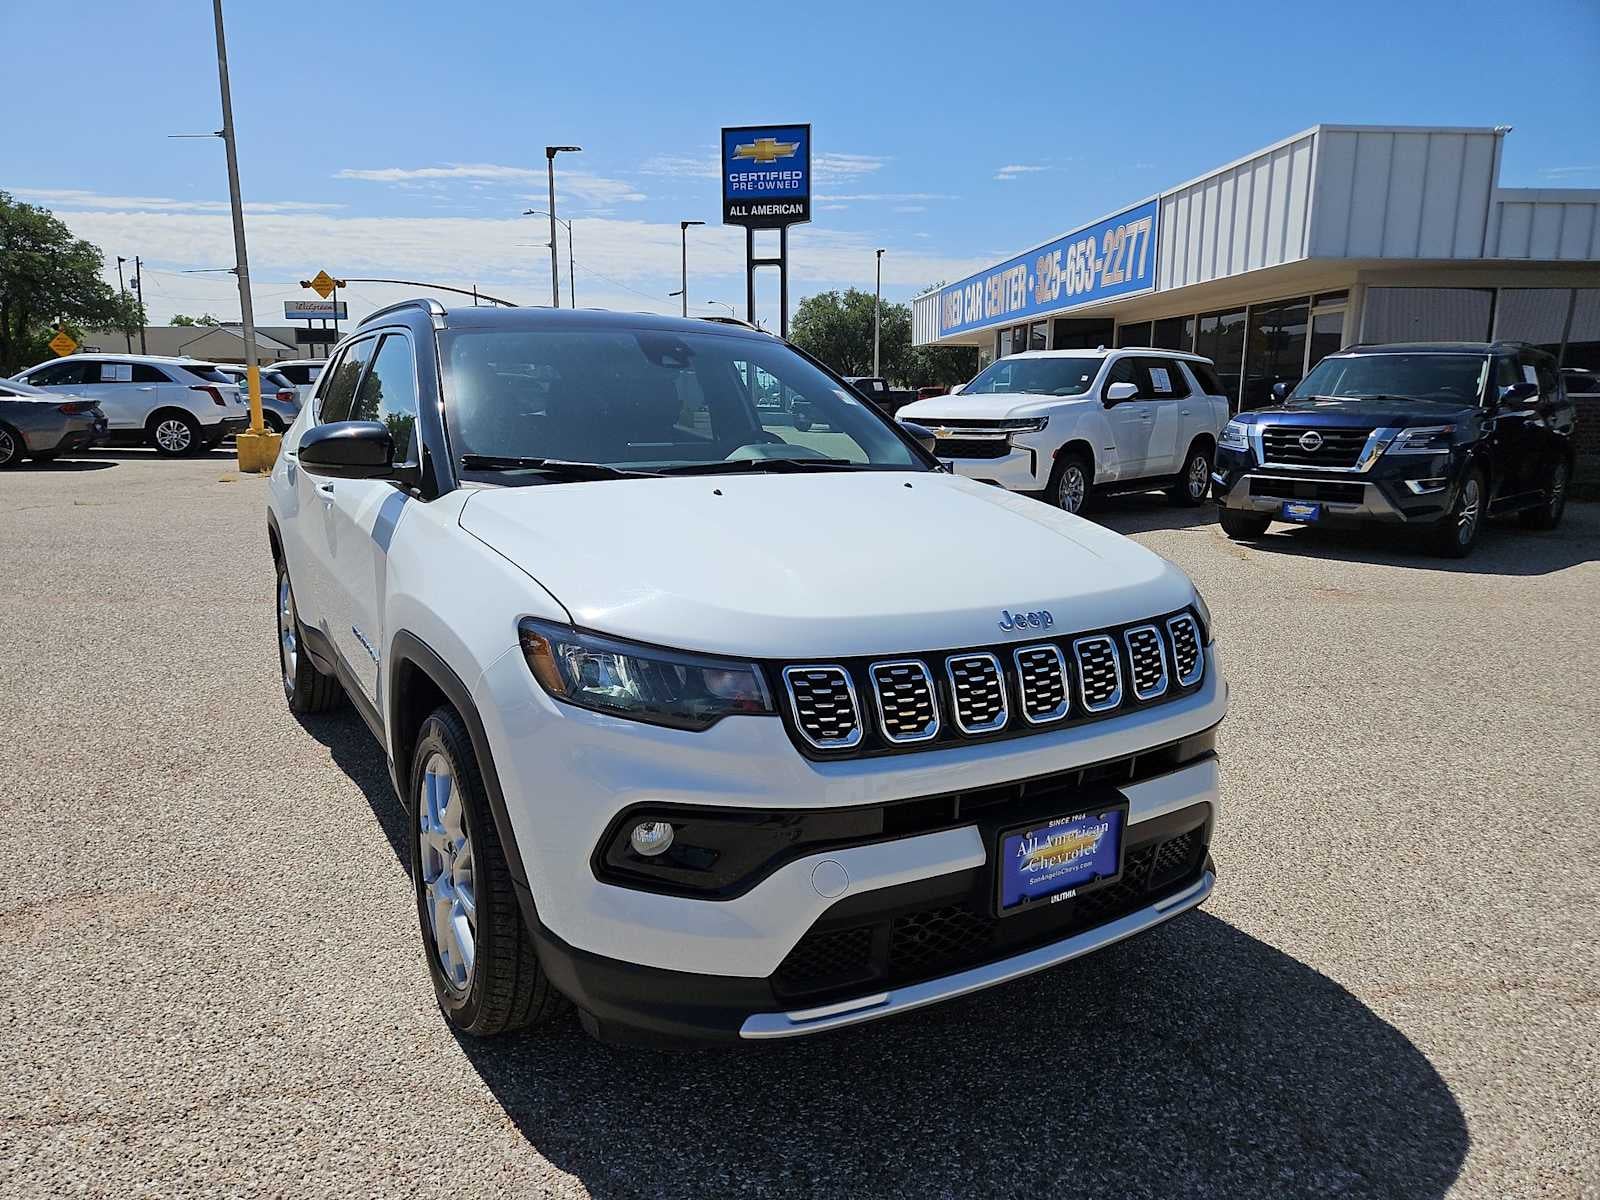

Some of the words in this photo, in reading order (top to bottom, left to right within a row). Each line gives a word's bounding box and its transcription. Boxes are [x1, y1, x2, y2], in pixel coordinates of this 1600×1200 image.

[729, 171, 802, 181] CERTIFIED
[732, 180, 799, 190] PRE-OWNED
[730, 206, 748, 216] ALL
[751, 203, 803, 216] AMERICAN
[943, 288, 962, 329] USED
[965, 281, 982, 324] CAR
[985, 264, 1027, 319] CENTER
[999, 610, 1053, 631] Jeep
[1048, 816, 1071, 828] SINCE
[1016, 836, 1038, 858] All
[1043, 822, 1109, 850] American
[1028, 841, 1098, 873] Chevrolet
